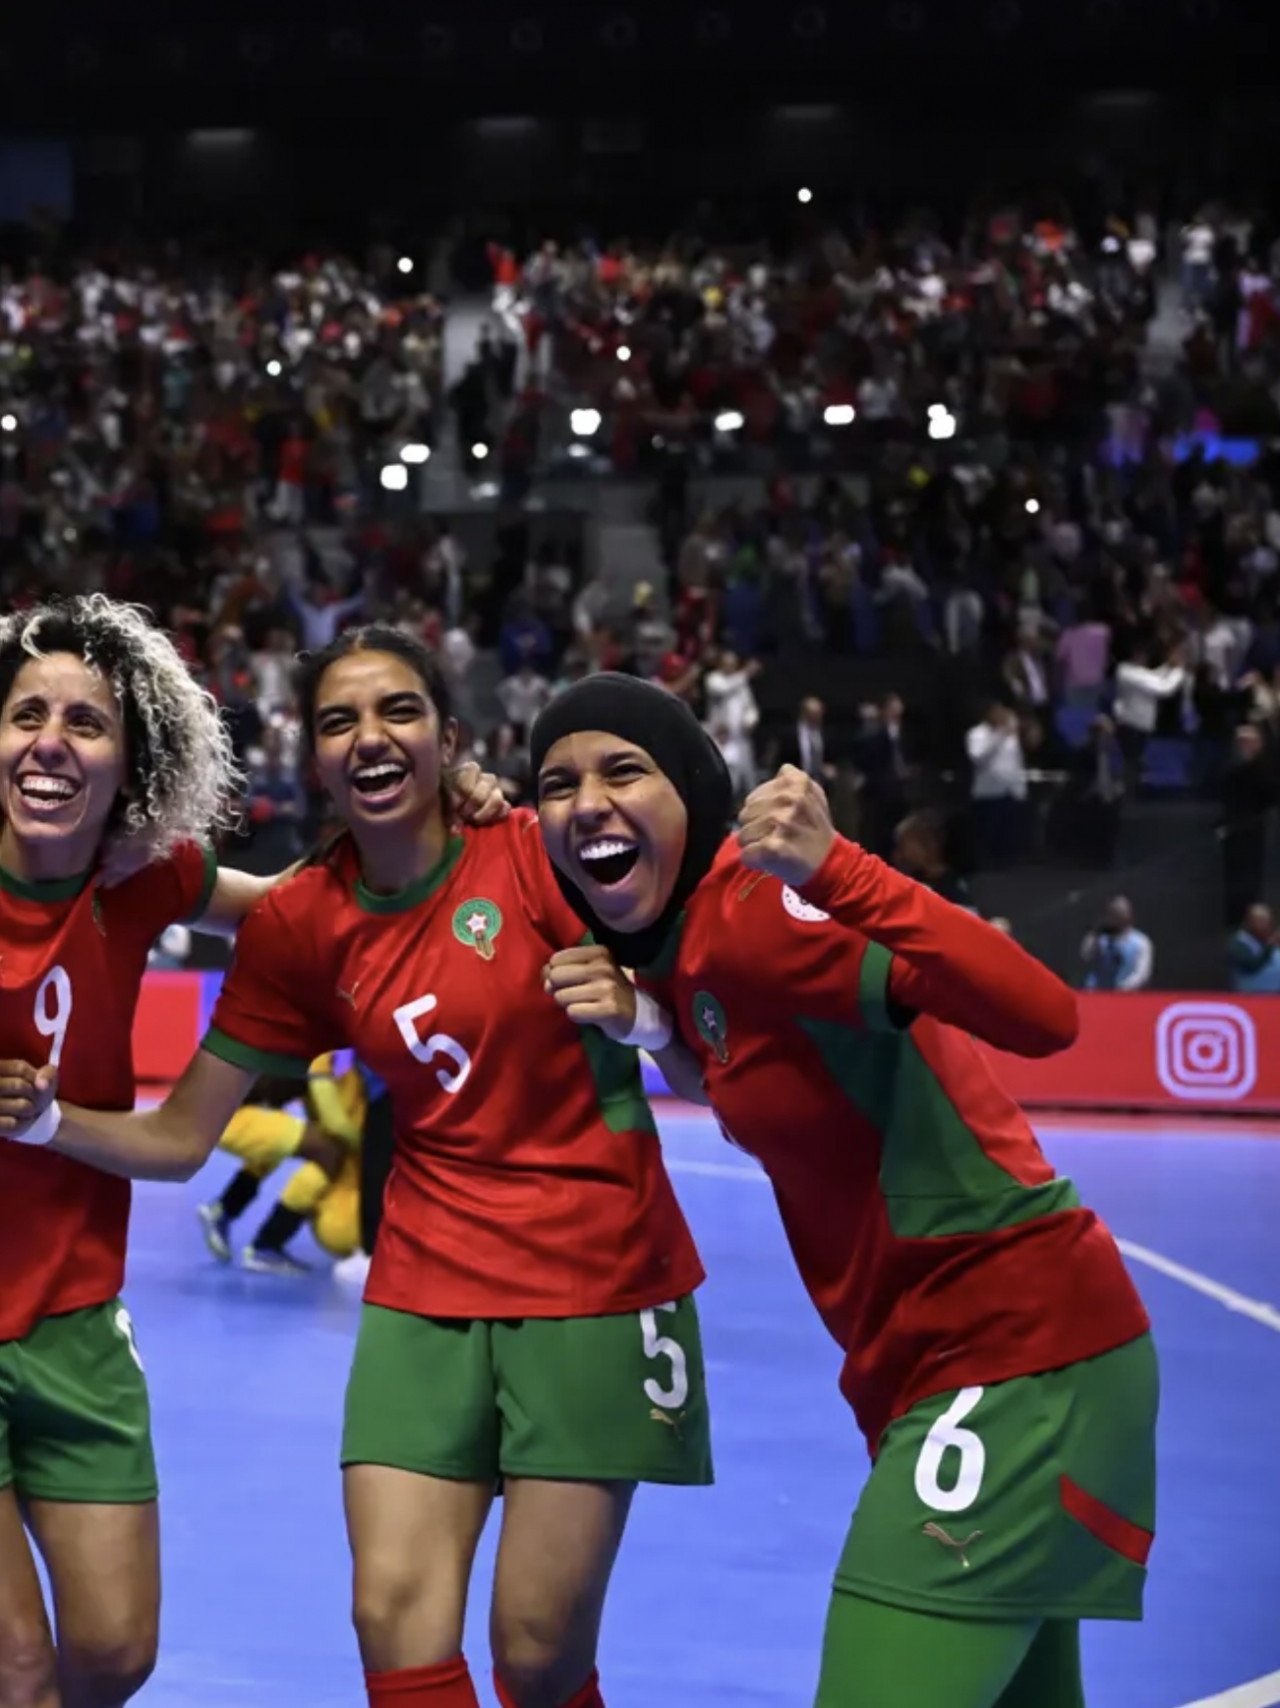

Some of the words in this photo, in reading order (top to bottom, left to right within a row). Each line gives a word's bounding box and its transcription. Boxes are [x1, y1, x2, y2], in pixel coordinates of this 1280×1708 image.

[33, 965, 72, 1068] 9
[393, 993, 471, 1093] 5
[640, 1301, 688, 1408] 5
[915, 1386, 985, 1511] 6
